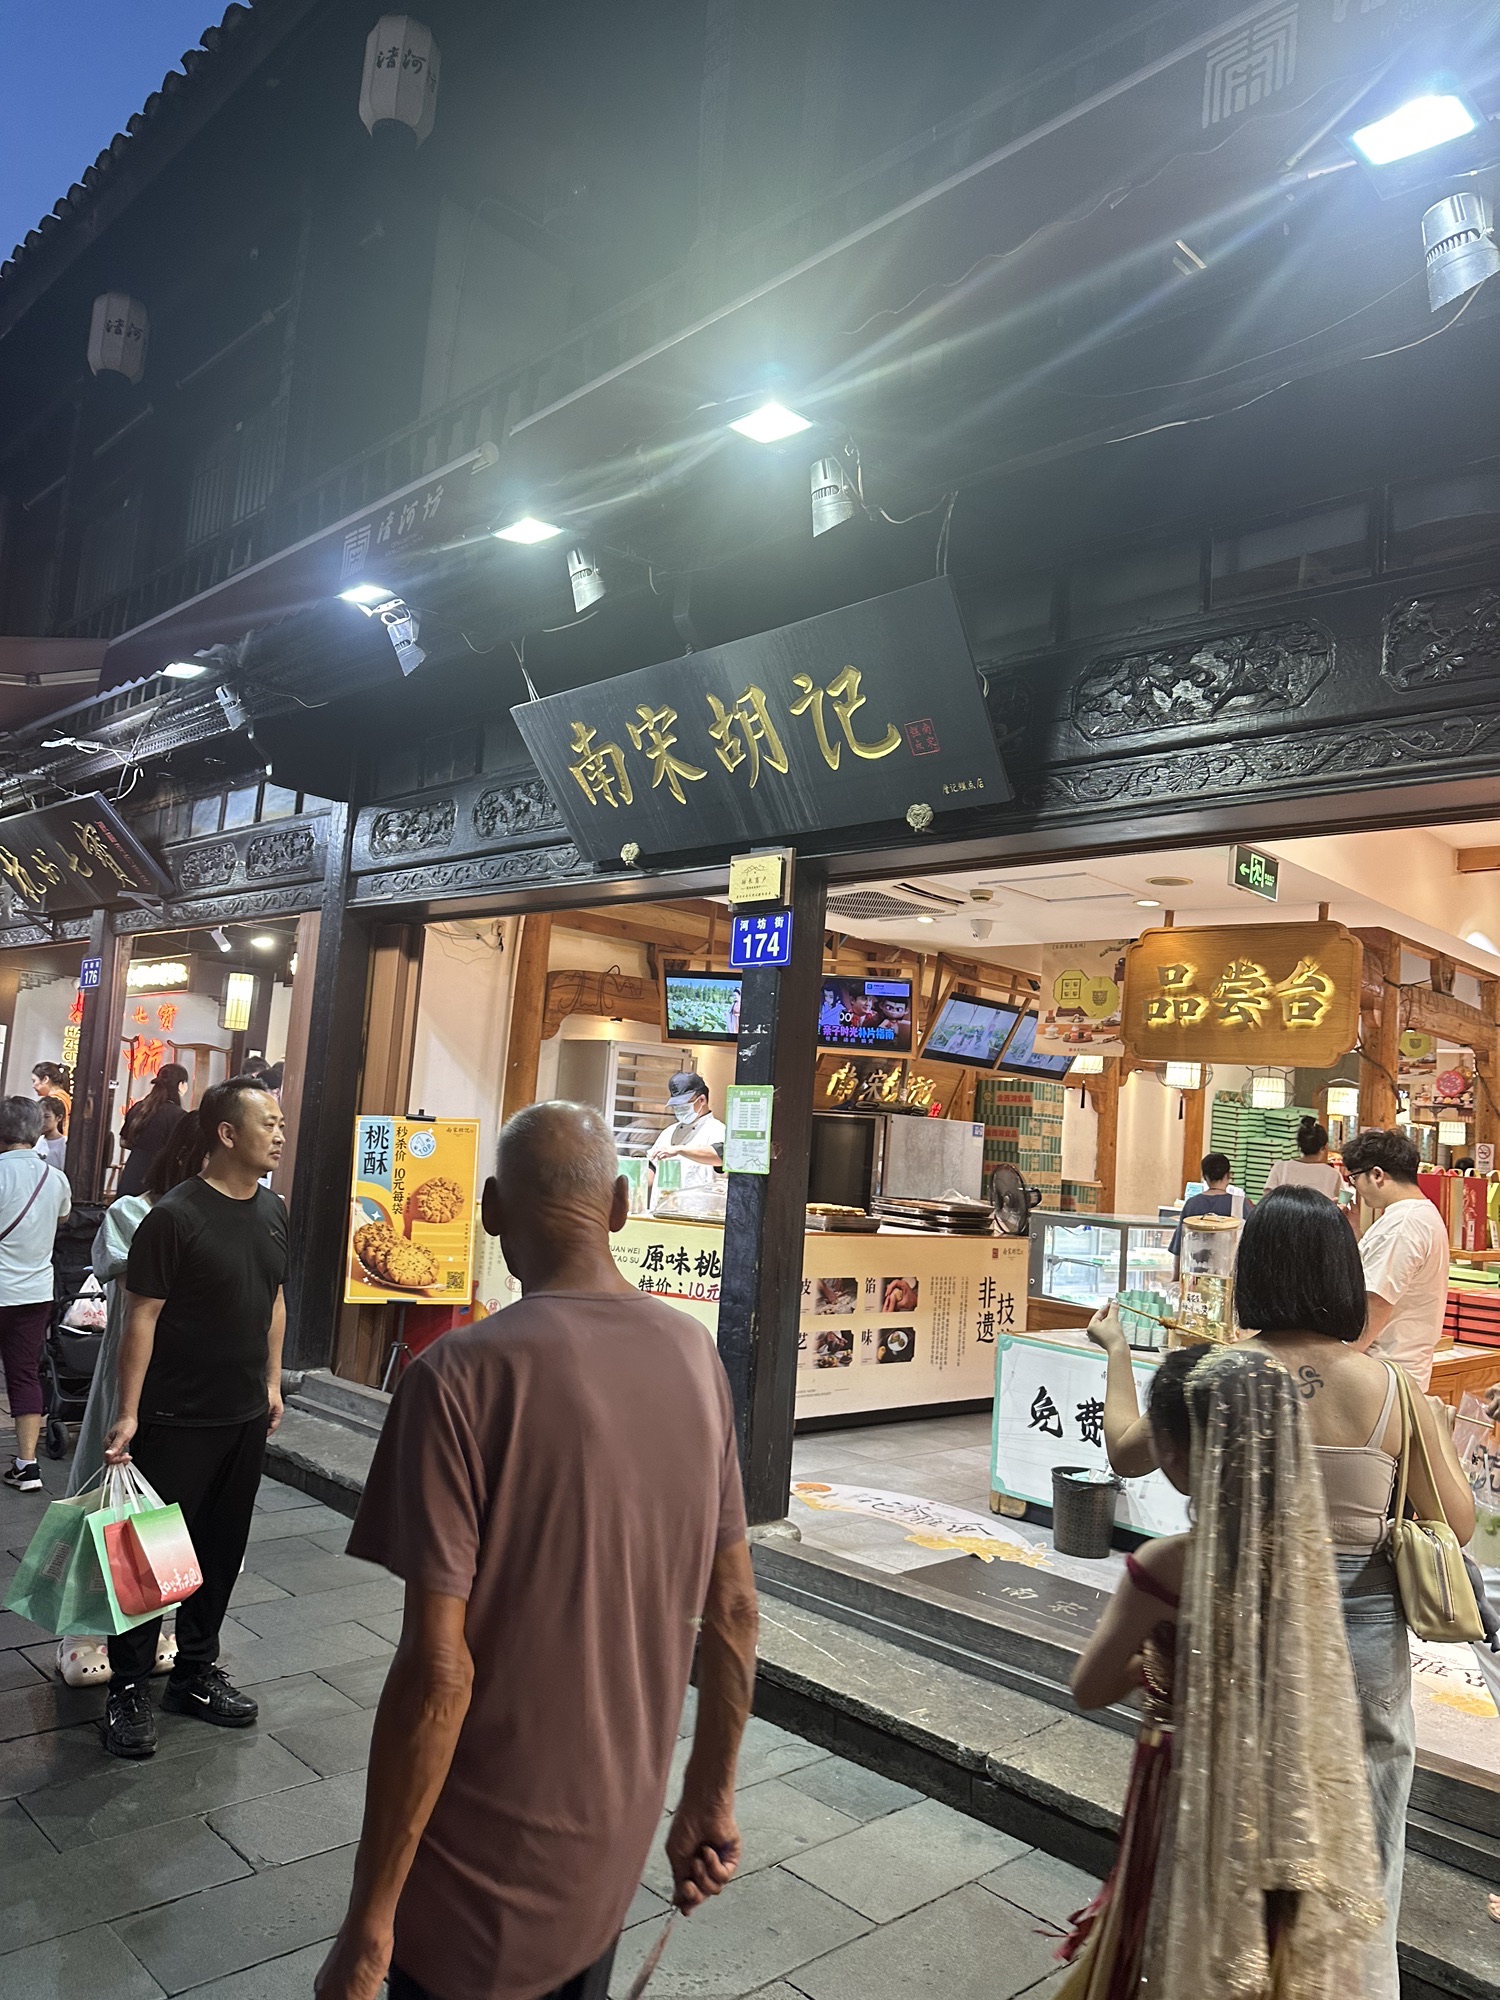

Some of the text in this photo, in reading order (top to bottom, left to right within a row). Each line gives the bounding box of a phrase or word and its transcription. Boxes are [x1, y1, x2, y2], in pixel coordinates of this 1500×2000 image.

[568, 665, 903, 807] 南宋胡记
[740, 916, 785, 932] 河坊街
[743, 931, 780, 958] 174
[84, 969, 98, 985] 176
[1143, 957, 1336, 1029] 品尝台
[823, 1024, 895, 1040] 亲子时光补片指南
[363, 1125, 390, 1175] 桃酥
[419, 1143, 432, 1155] TOP
[392, 1126, 409, 1215] 秒杀价 10元每袋
[610, 1245, 641, 1255] UAN WEI
[629, 1256, 640, 1264] SU
[639, 1244, 721, 1278] 原味桃
[865, 1277, 876, 1294] 馅
[976, 1276, 997, 1344] 非遗
[996, 1292, 1016, 1334] 技
[861, 1328, 873, 1346] 味
[1027, 1385, 1106, 1448] 免费
